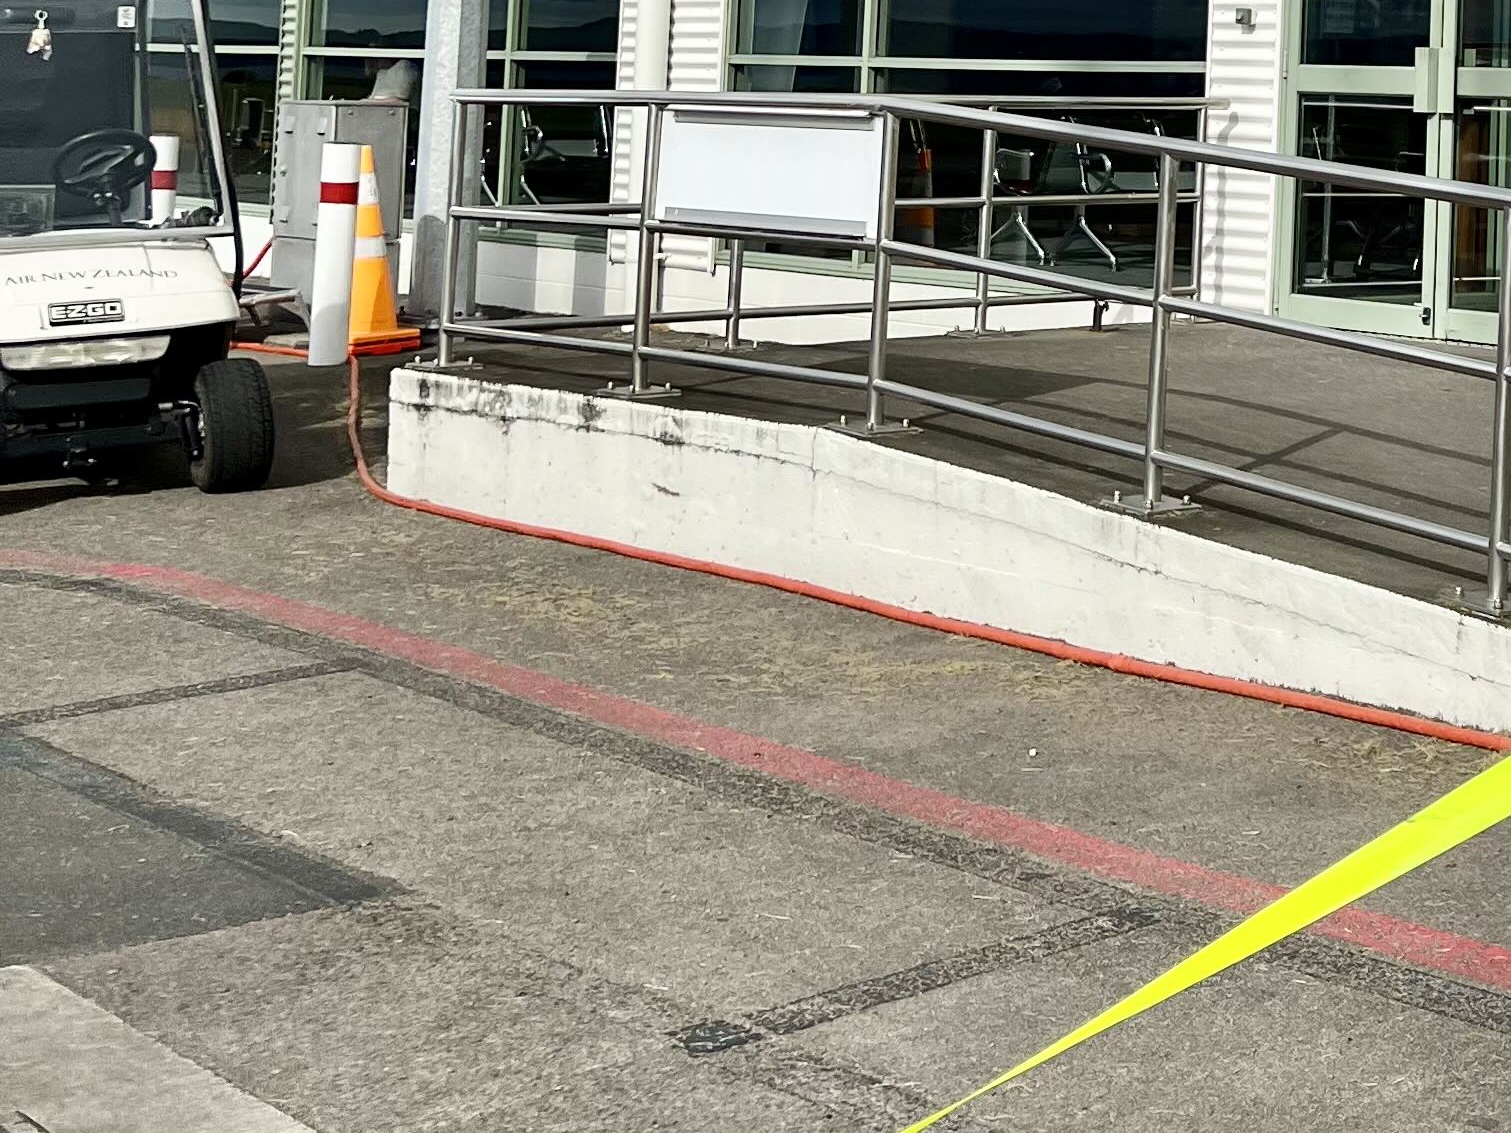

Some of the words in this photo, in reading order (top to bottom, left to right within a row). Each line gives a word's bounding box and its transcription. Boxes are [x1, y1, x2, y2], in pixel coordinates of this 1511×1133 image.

[5, 275, 36, 285] AIR
[41, 270, 87, 281] NEW
[93, 268, 178, 278] ZEALAND
